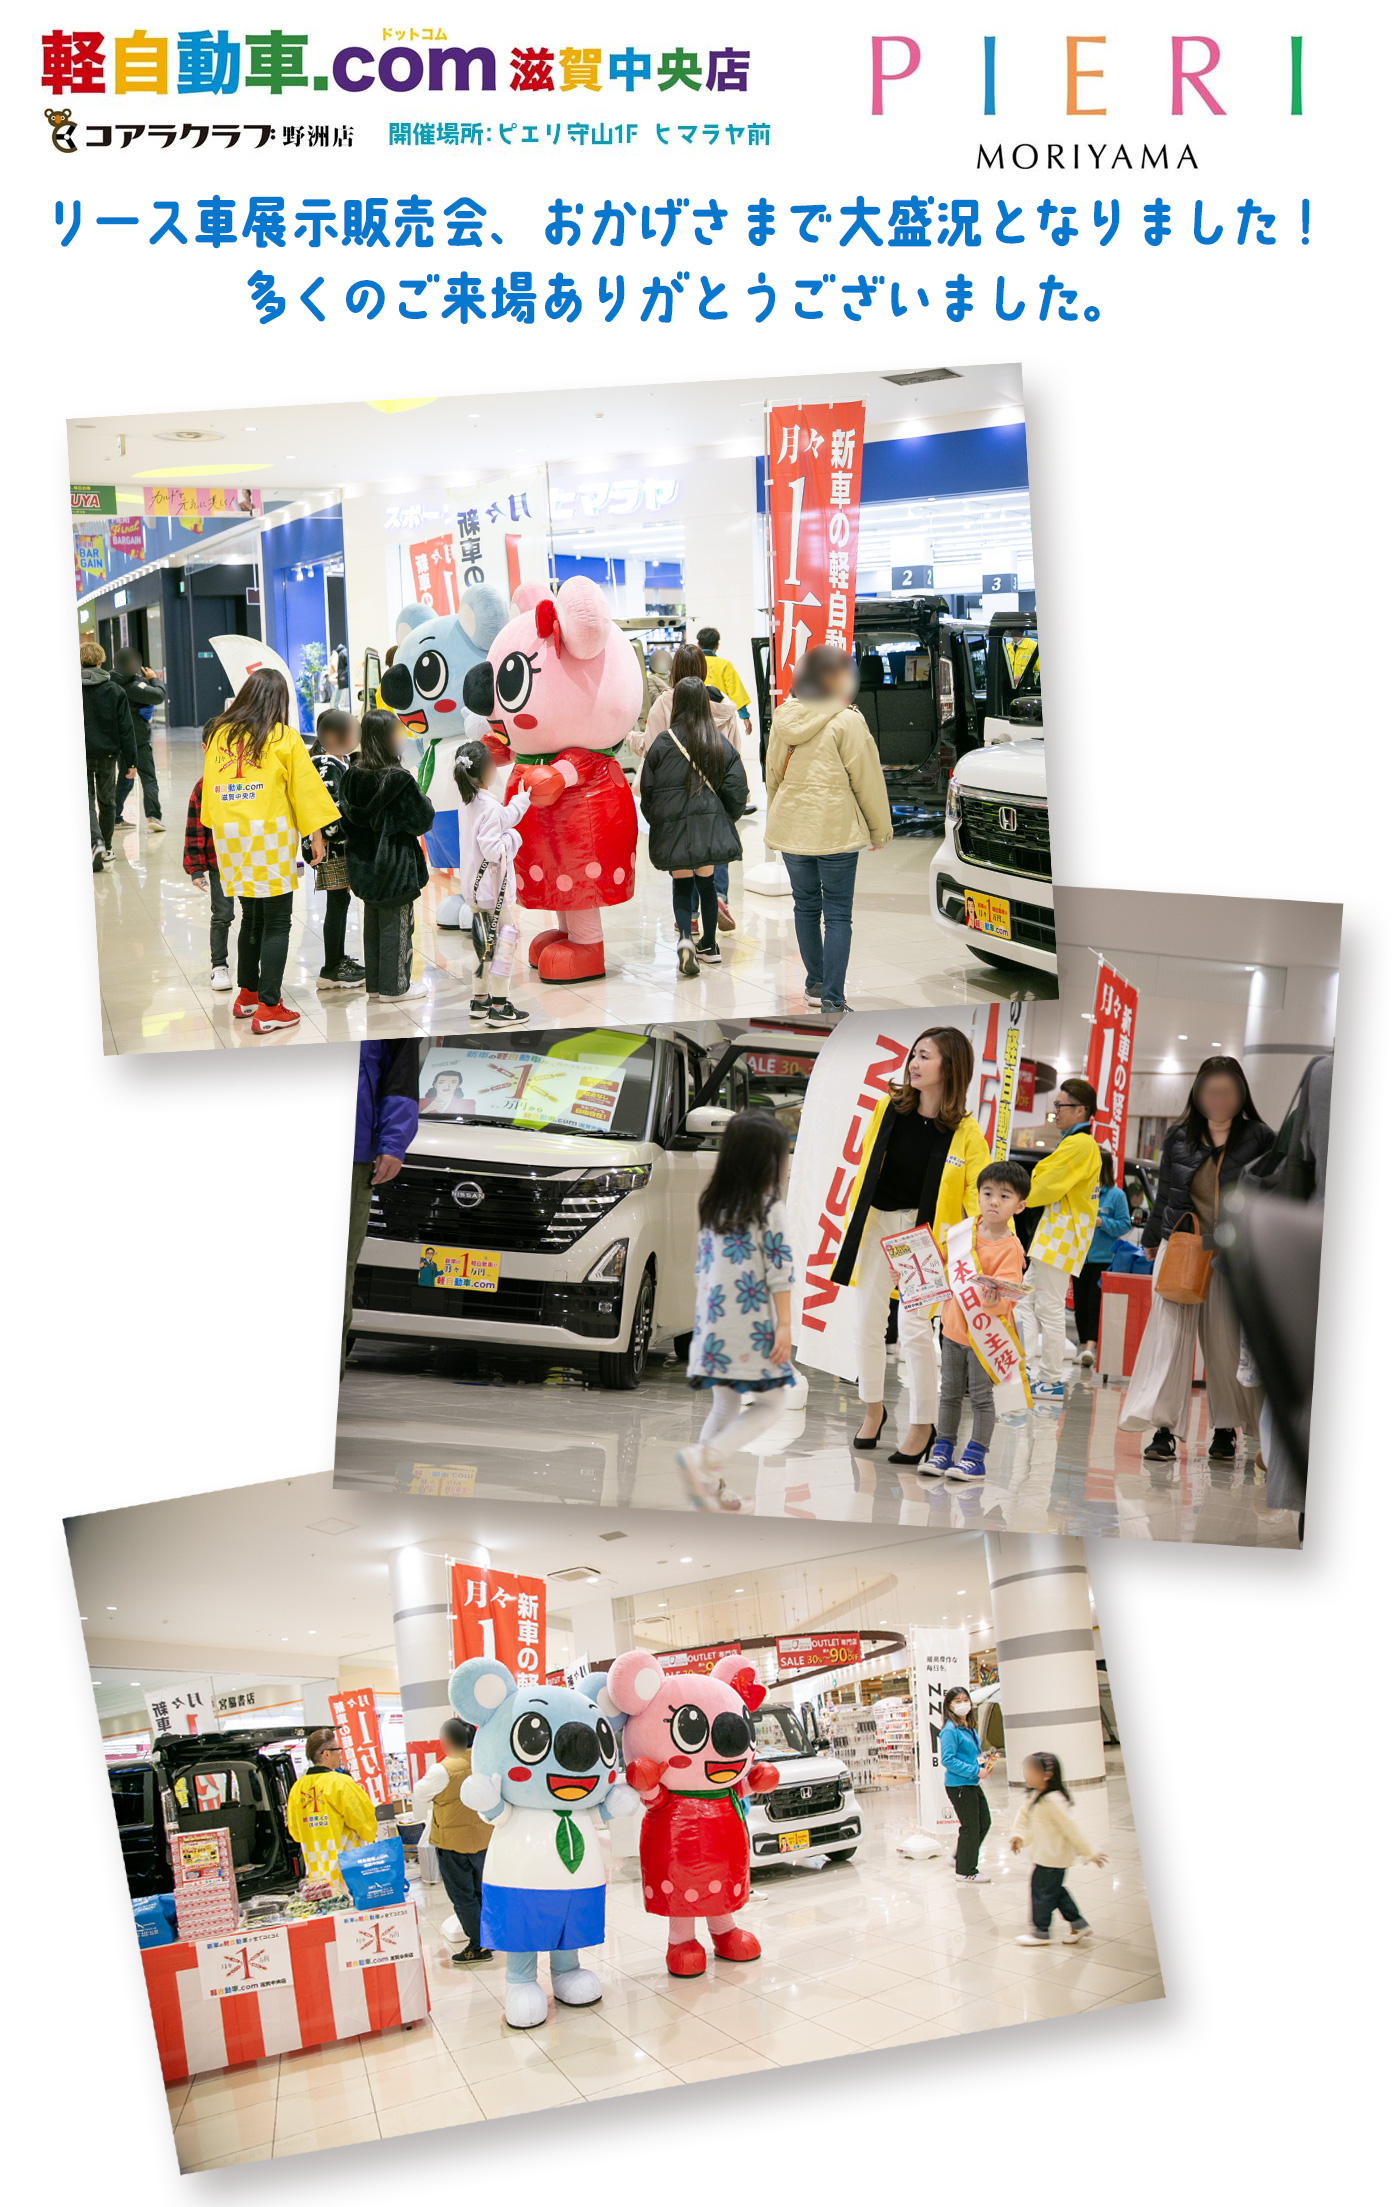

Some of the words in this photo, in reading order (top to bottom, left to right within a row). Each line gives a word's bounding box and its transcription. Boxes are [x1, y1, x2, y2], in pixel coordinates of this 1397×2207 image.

[776, 424, 825, 464] 月々
[546, 480, 678, 521] ヒマラヤ
[113, 536, 142, 545] BARGAIN
[79, 548, 99, 558] BAR
[80, 558, 103, 569] GAIN
[902, 570, 913, 586] 2
[991, 577, 1001, 591] 3
[802, 1034, 909, 1333] NISSAN
[451, 1190, 485, 1200] NISSAN
[436, 1276, 496, 1289] 軽自動車.com
[953, 1260, 1018, 1375] 本日の主役
[811, 1638, 839, 1648] OUTLET
[687, 1651, 717, 1663] OUTLET
[781, 1656, 805, 1667] SALE
